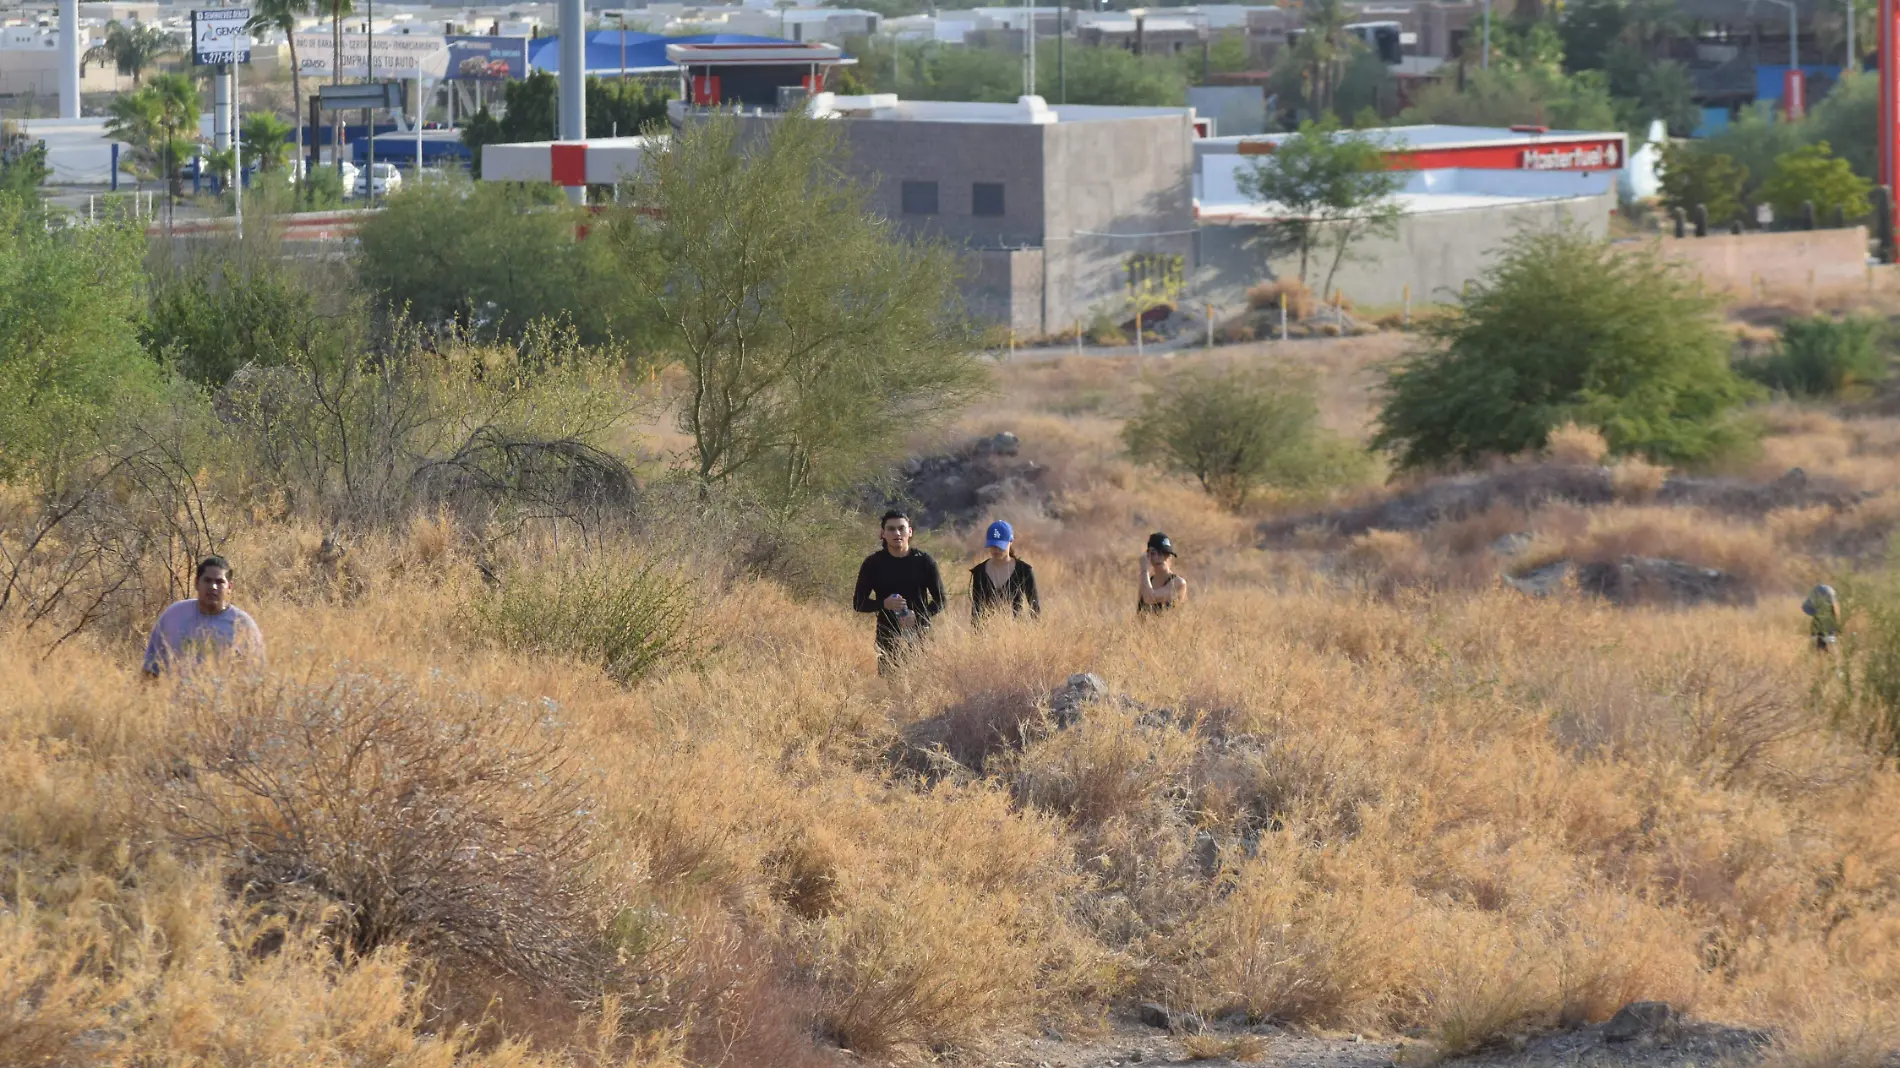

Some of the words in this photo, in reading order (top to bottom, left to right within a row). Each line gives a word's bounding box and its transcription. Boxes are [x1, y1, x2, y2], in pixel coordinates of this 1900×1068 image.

[384, 56, 394, 67] TU
[395, 56, 414, 68] AUTO
[1523, 145, 1603, 169] Masterfuel
